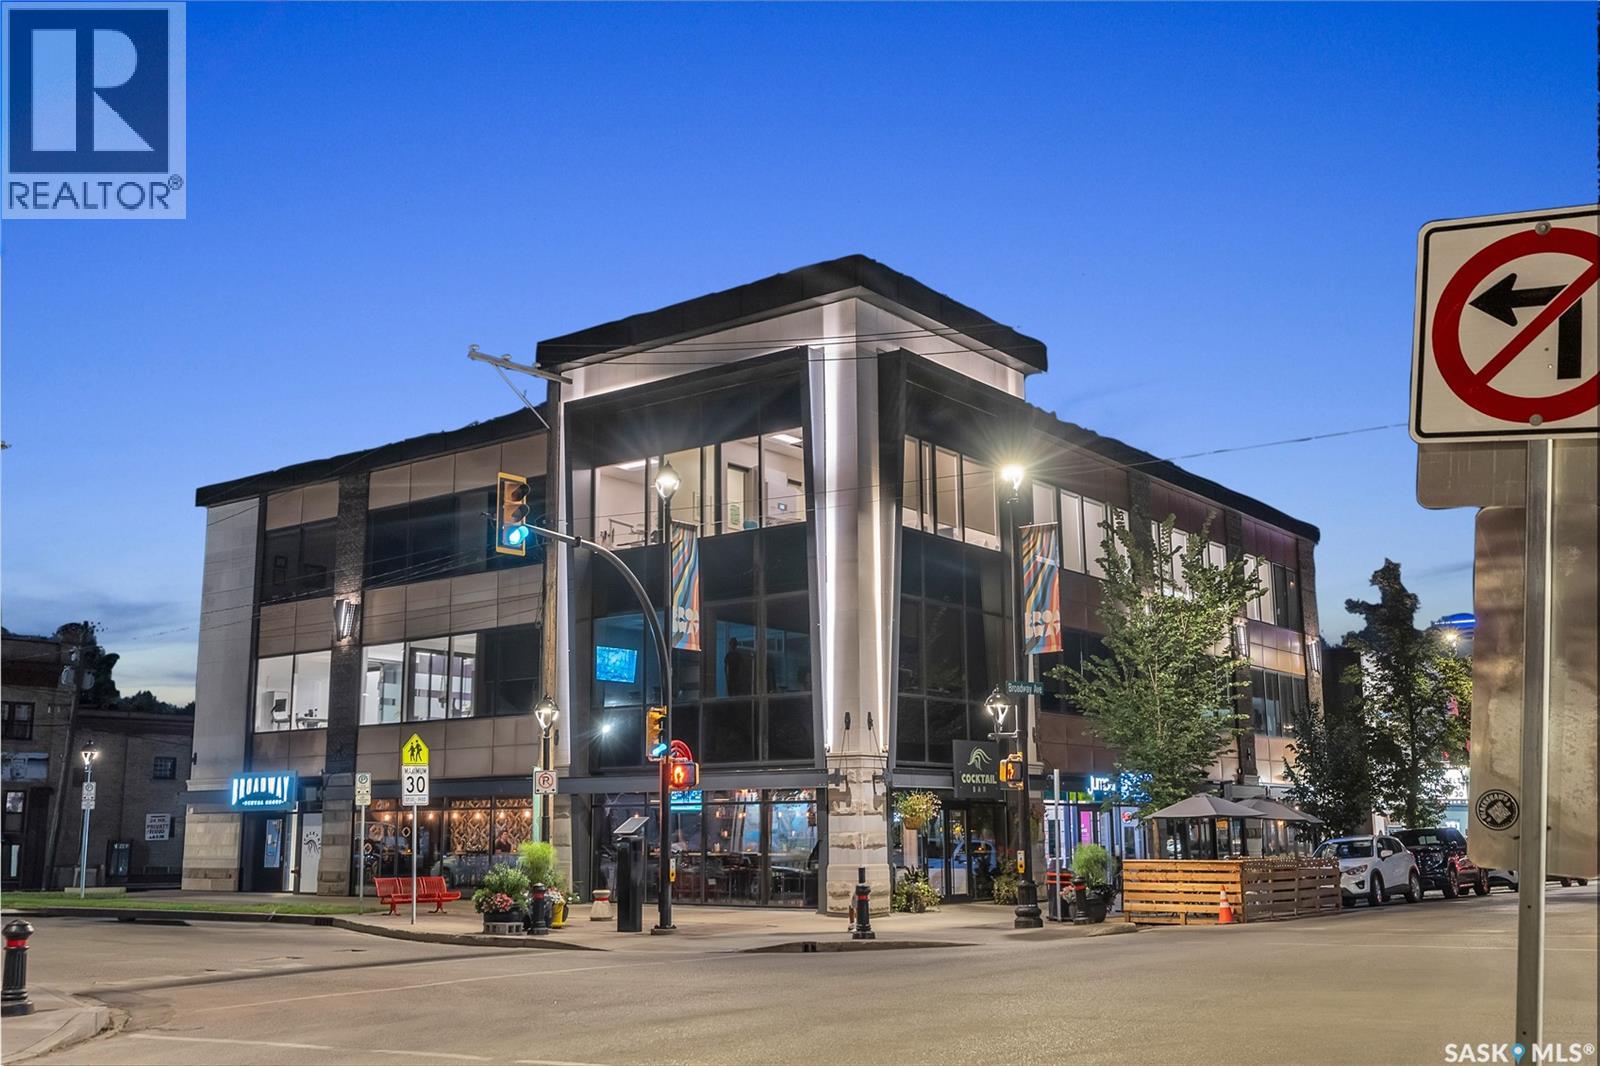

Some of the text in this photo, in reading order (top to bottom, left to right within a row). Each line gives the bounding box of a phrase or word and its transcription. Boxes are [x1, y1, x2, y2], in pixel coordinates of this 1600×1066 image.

[1008, 682, 1042, 694] Broadway Ave
[406, 776, 425, 793] 30
[961, 773, 998, 784] COCKTAIL
[231, 776, 290, 806] BROADWAY
[972, 785, 987, 793] BAR
